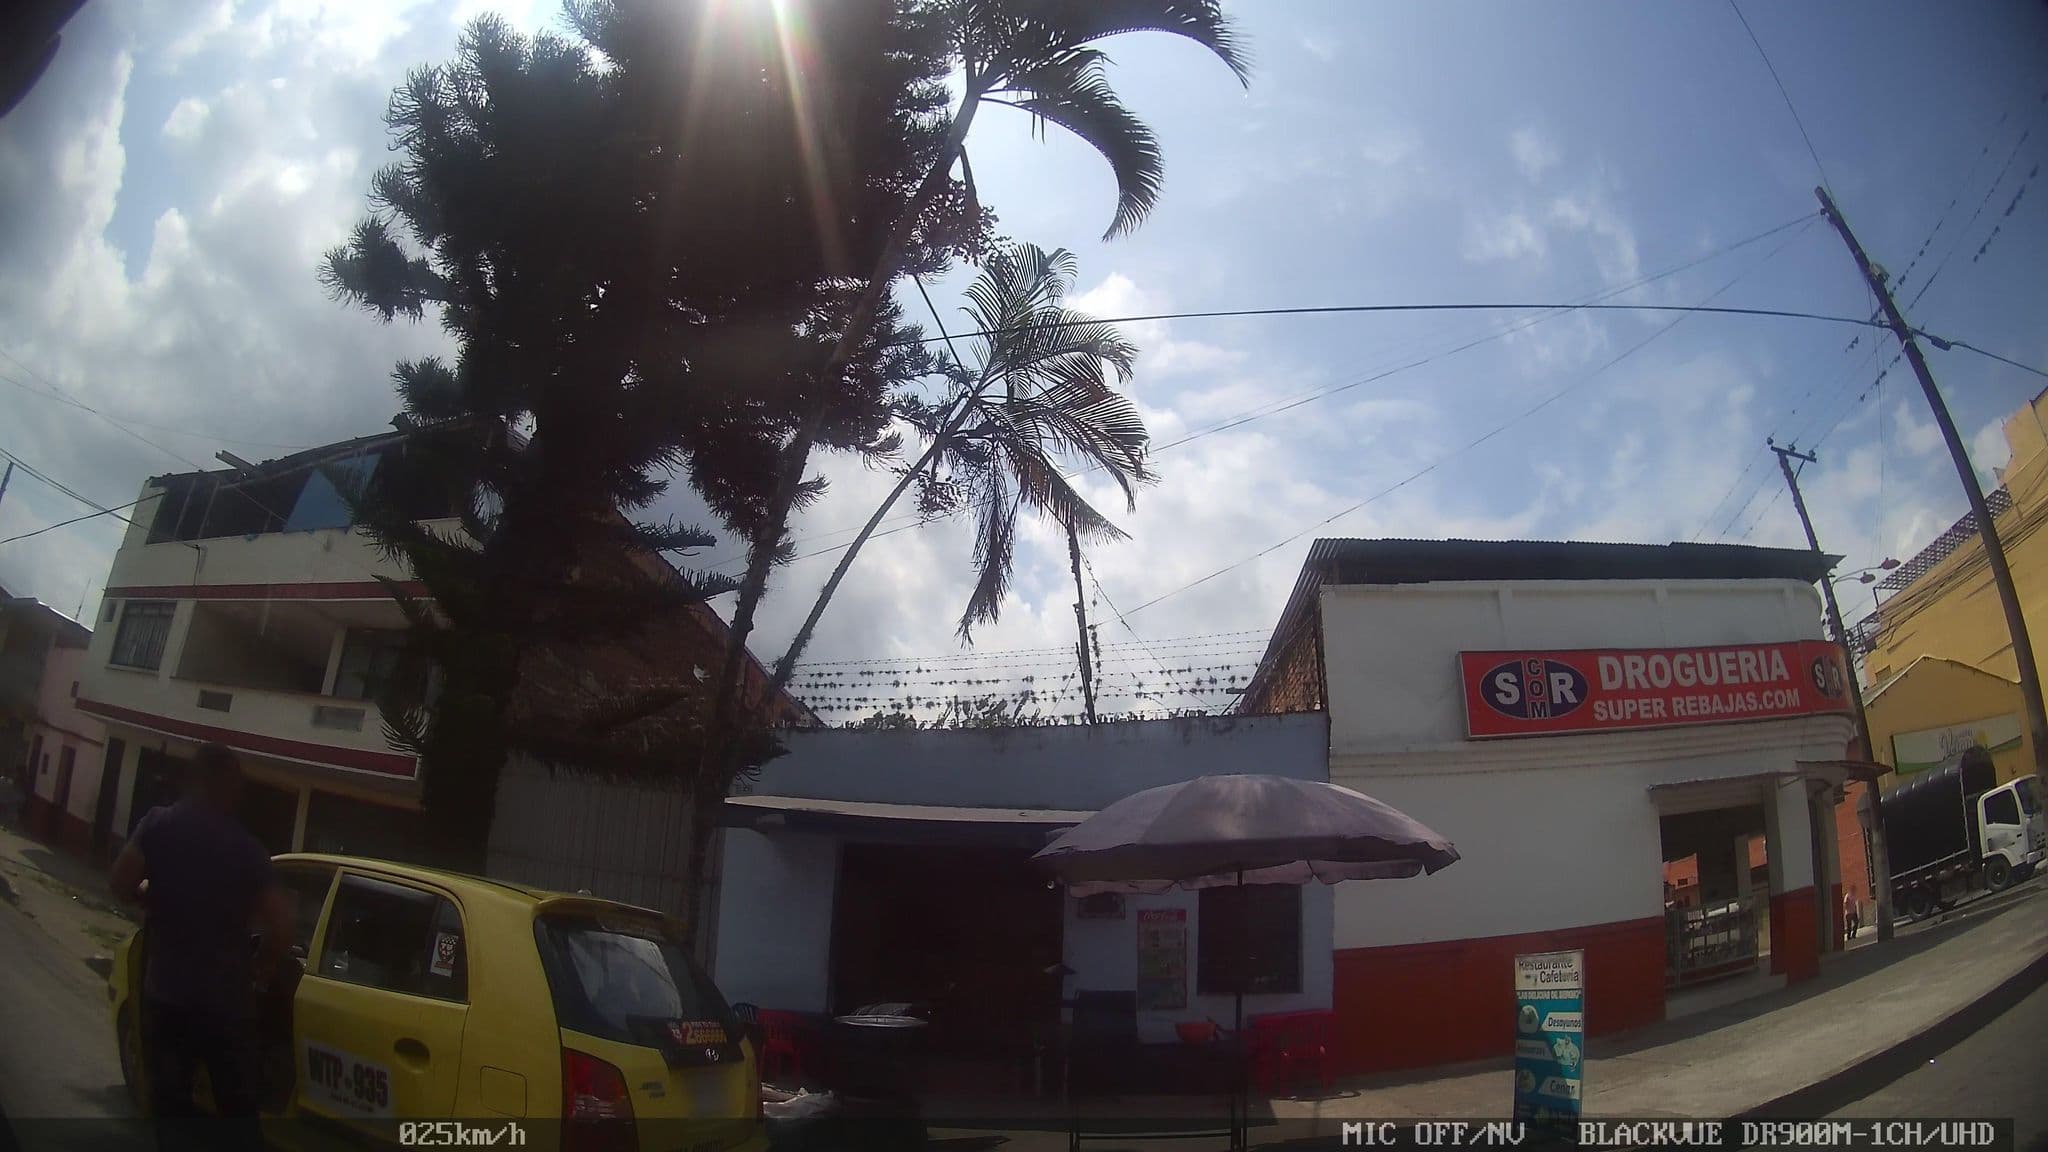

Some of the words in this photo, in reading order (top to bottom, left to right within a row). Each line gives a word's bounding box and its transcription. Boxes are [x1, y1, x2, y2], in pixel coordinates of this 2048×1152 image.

[1598, 649, 1790, 691] DROGUERIA
[1593, 697, 1667, 721] SUPER
[1672, 688, 1800, 718] REBAJAS.COM
